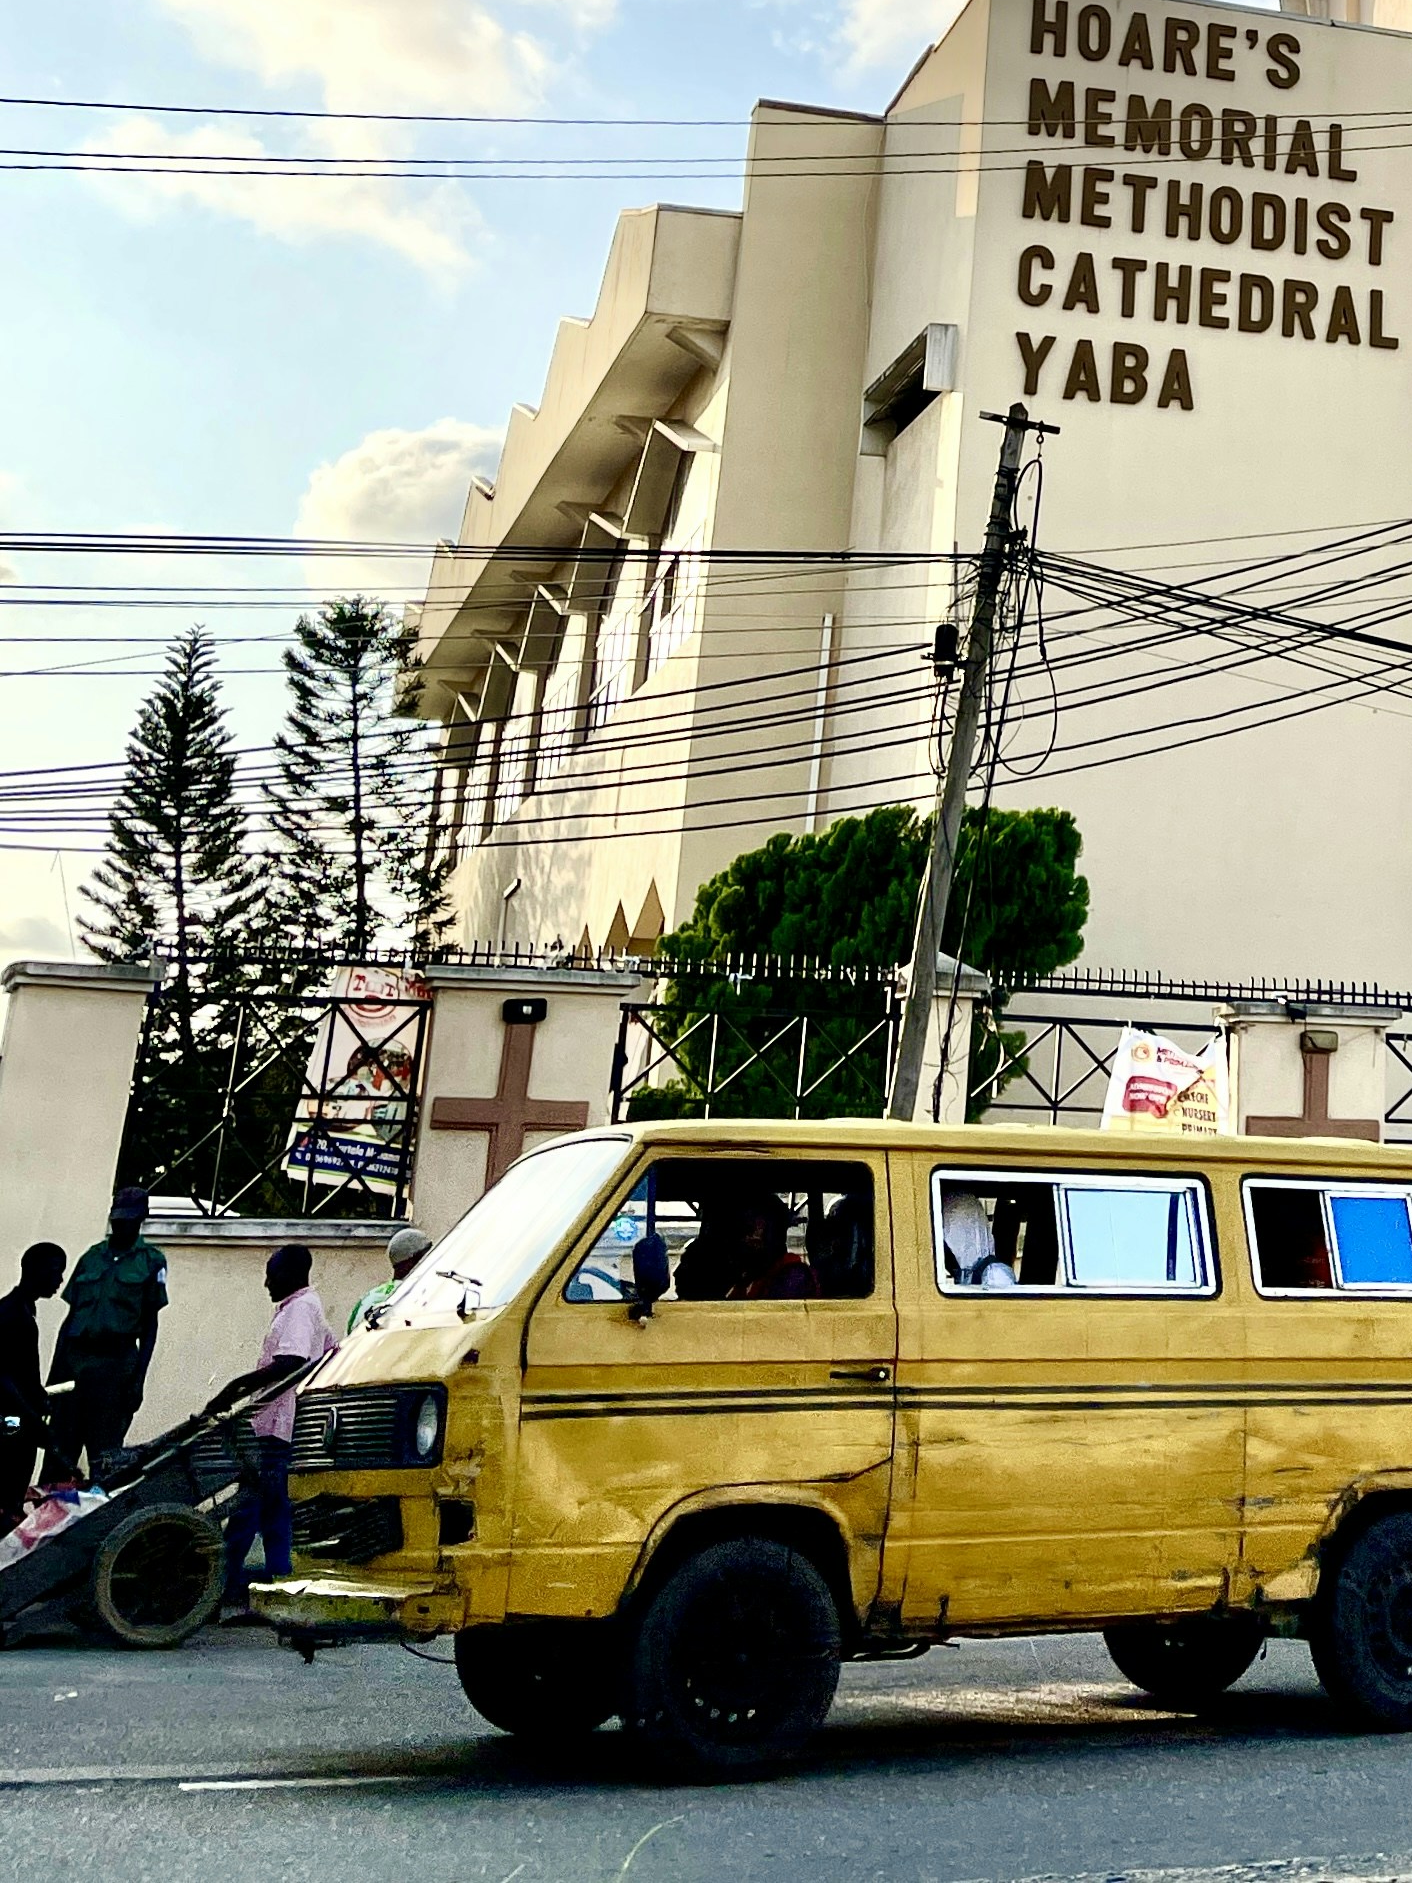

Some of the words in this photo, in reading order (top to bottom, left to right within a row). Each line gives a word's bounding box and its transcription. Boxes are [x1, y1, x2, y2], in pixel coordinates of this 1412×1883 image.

[1027, 77, 1357, 182] MEMORIAL
[1022, 159, 1394, 266] METHODIST
[1017, 244, 1399, 350] CATHEDRAL
[1016, 331, 1194, 411] YABA
[1182, 1107, 1216, 1123] NURSERY
